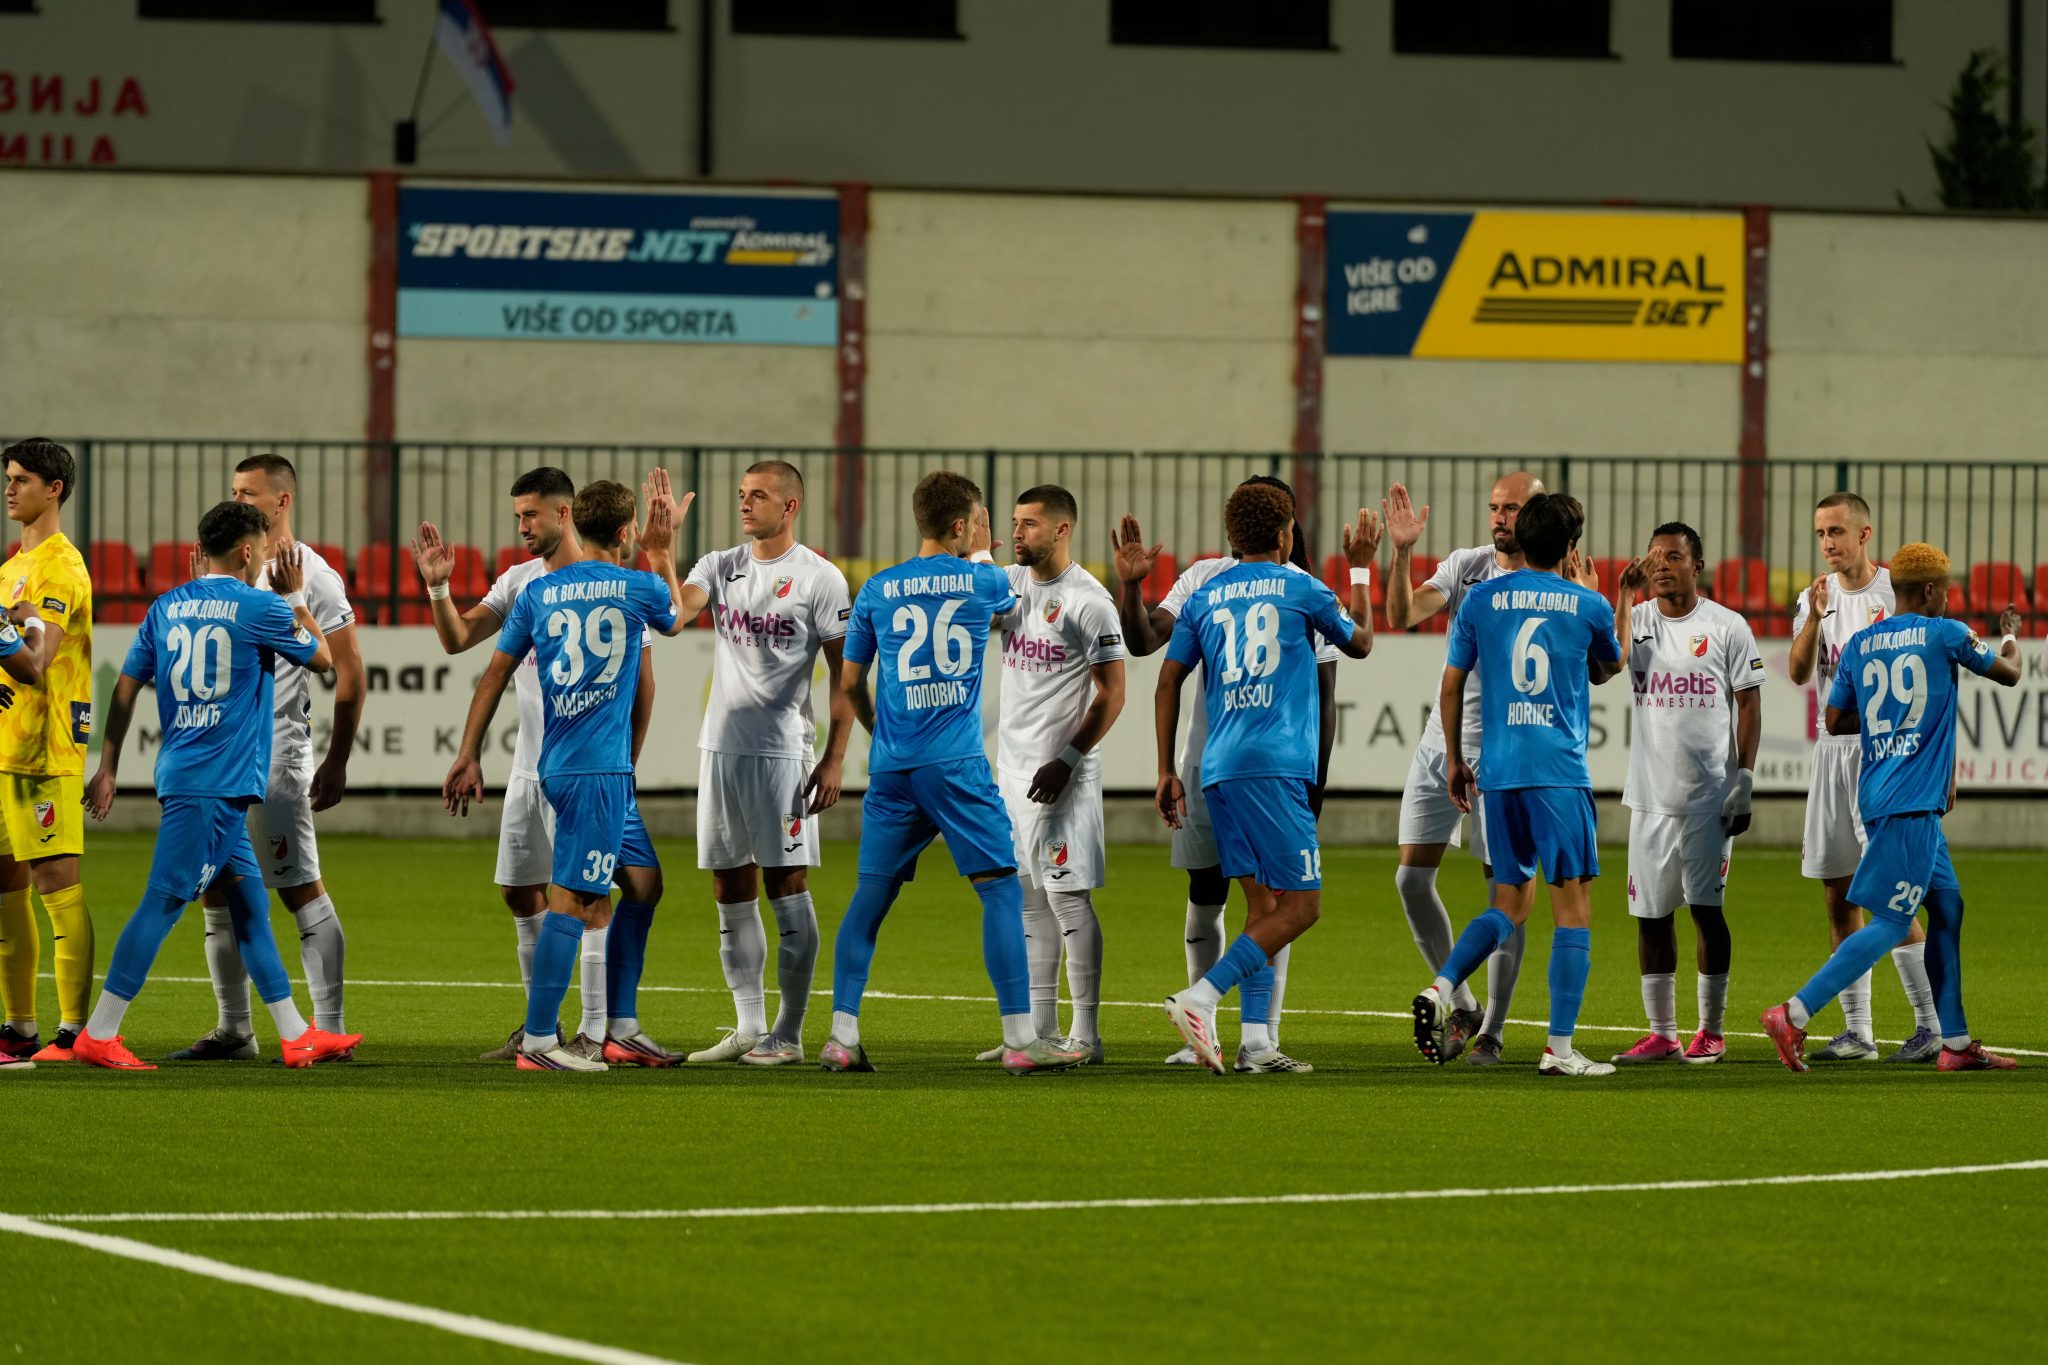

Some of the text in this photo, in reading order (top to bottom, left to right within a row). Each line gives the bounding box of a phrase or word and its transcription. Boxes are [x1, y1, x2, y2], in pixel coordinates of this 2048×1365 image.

[412, 222, 729, 264] SPORTSKE.NET
[1397, 256, 1437, 284] OD
[1488, 251, 1726, 294] ADMIRAL
[502, 299, 736, 337] VIŠE OD SPORTA
[1641, 300, 1724, 327] BET
[543, 580, 627, 605] ФК ВОЖДОВАЦ
[883, 573, 975, 599] ФК ВОЖДОВАЦ
[1208, 578, 1286, 606] ФК ВОЖДОВАЦ
[1491, 590, 1579, 616] ФК ВОЖДОВАЦ
[728, 608, 796, 637] Matis
[547, 605, 627, 687] 39
[721, 630, 791, 650] AMEŠTAJ
[892, 599, 973, 683] 26
[1005, 630, 1067, 662] Matis
[1212, 601, 1281, 686] 18
[166, 624, 232, 702] 20
[1002, 656, 1064, 674] AMEŠTAJ
[1511, 617, 1550, 696] 6
[905, 680, 967, 711] ПОПОВИЋ
[1650, 672, 1717, 695] Matis
[1862, 652, 1928, 737] 29
[1507, 702, 1554, 728] HORIKE
[1636, 696, 1715, 708] NAMEŠTAJ
[583, 850, 616, 885] 39
[1887, 880, 1923, 916] 29
